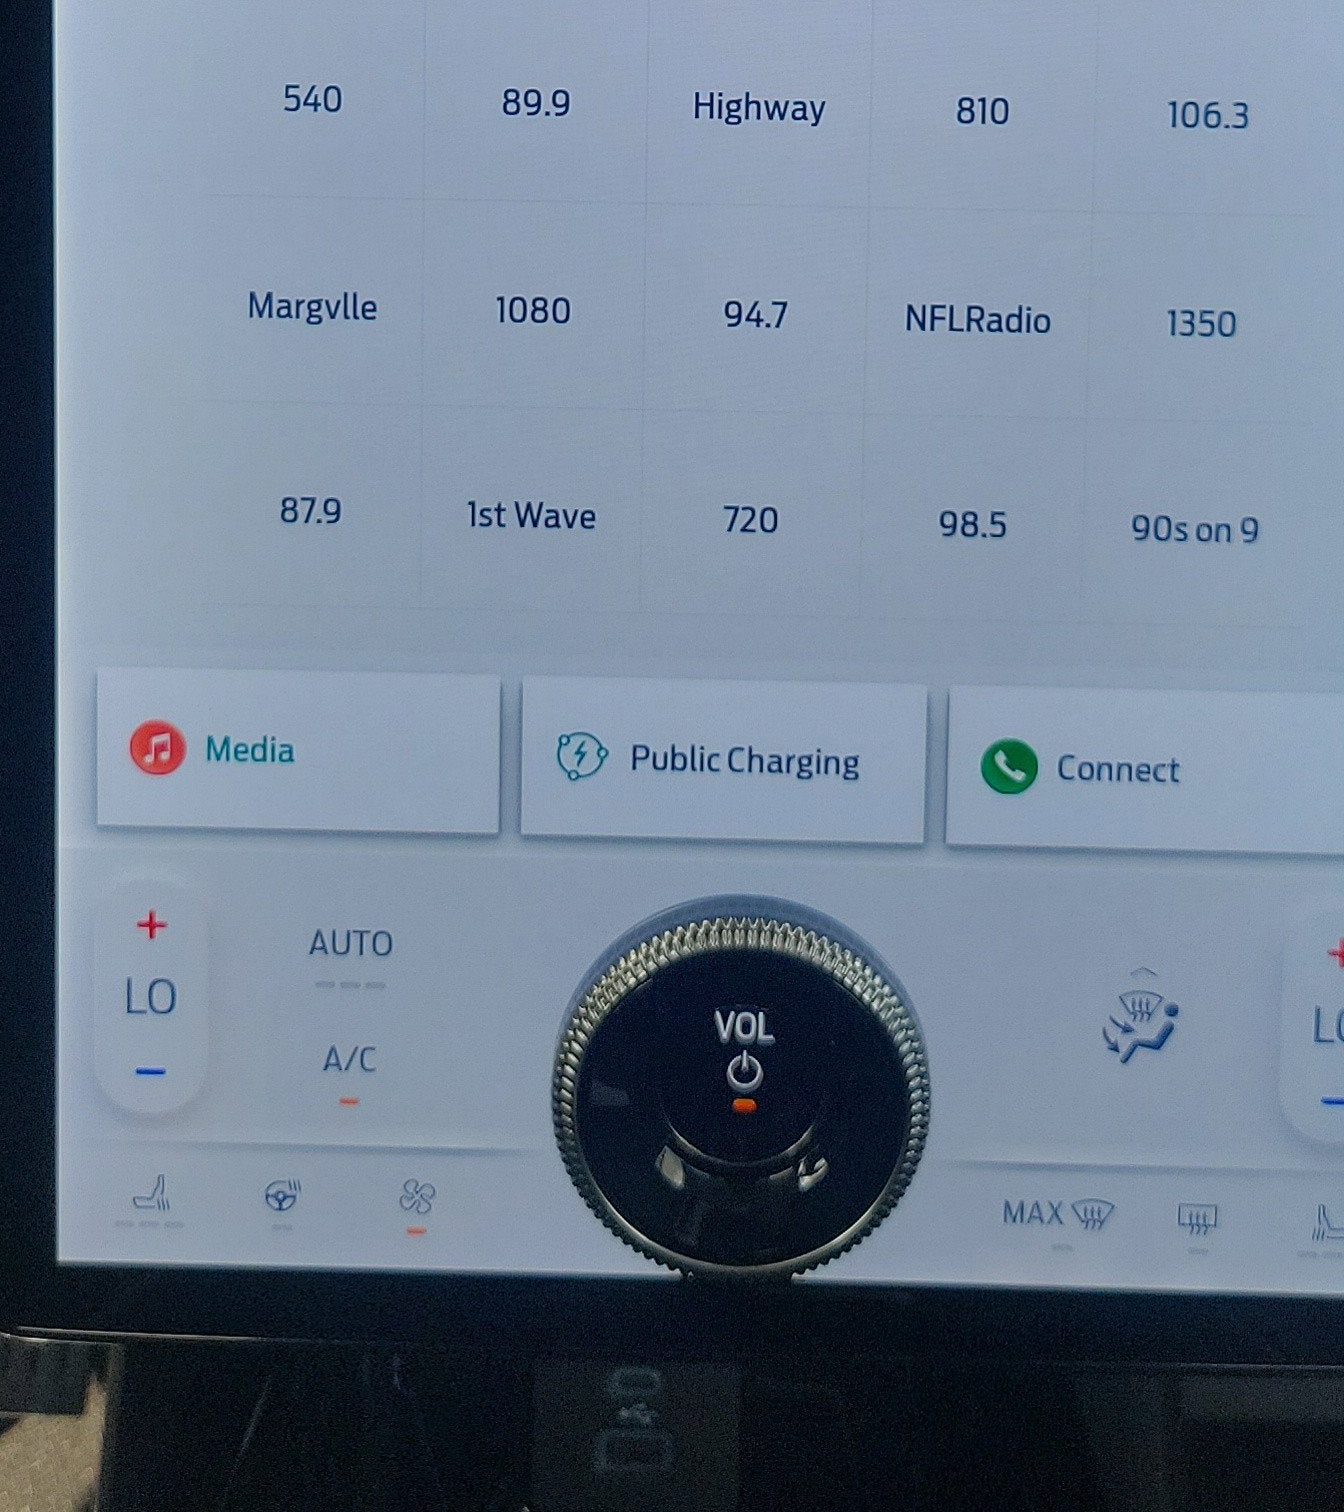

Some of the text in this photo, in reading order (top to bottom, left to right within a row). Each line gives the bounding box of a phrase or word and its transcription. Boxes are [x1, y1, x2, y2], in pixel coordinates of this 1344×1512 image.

[284, 84, 342, 113] 540
[502, 88, 570, 117] 89.9
[694, 91, 826, 128] Highway
[956, 96, 1010, 126] 810
[1168, 100, 1249, 130] 106.3
[248, 291, 378, 326] Margvlle
[496, 295, 571, 325] 1080
[724, 300, 788, 329] 94.7
[906, 303, 1051, 334] NFLRadio
[1167, 309, 1237, 338] 1350
[280, 496, 342, 525] 87.9
[467, 500, 596, 530] 1st Wave
[723, 505, 779, 534] 720
[939, 510, 1007, 539] 98.5
[1131, 514, 1259, 544] 90s on 9
[206, 735, 295, 764] Media
[631, 743, 860, 782] Public Charging
[1057, 754, 1180, 784] Connect
[308, 929, 393, 957] AUTO
[126, 977, 177, 1015] LO
[715, 1010, 775, 1042] VOL
[322, 1045, 376, 1073] A/C
[1003, 1200, 1064, 1225] MAX
